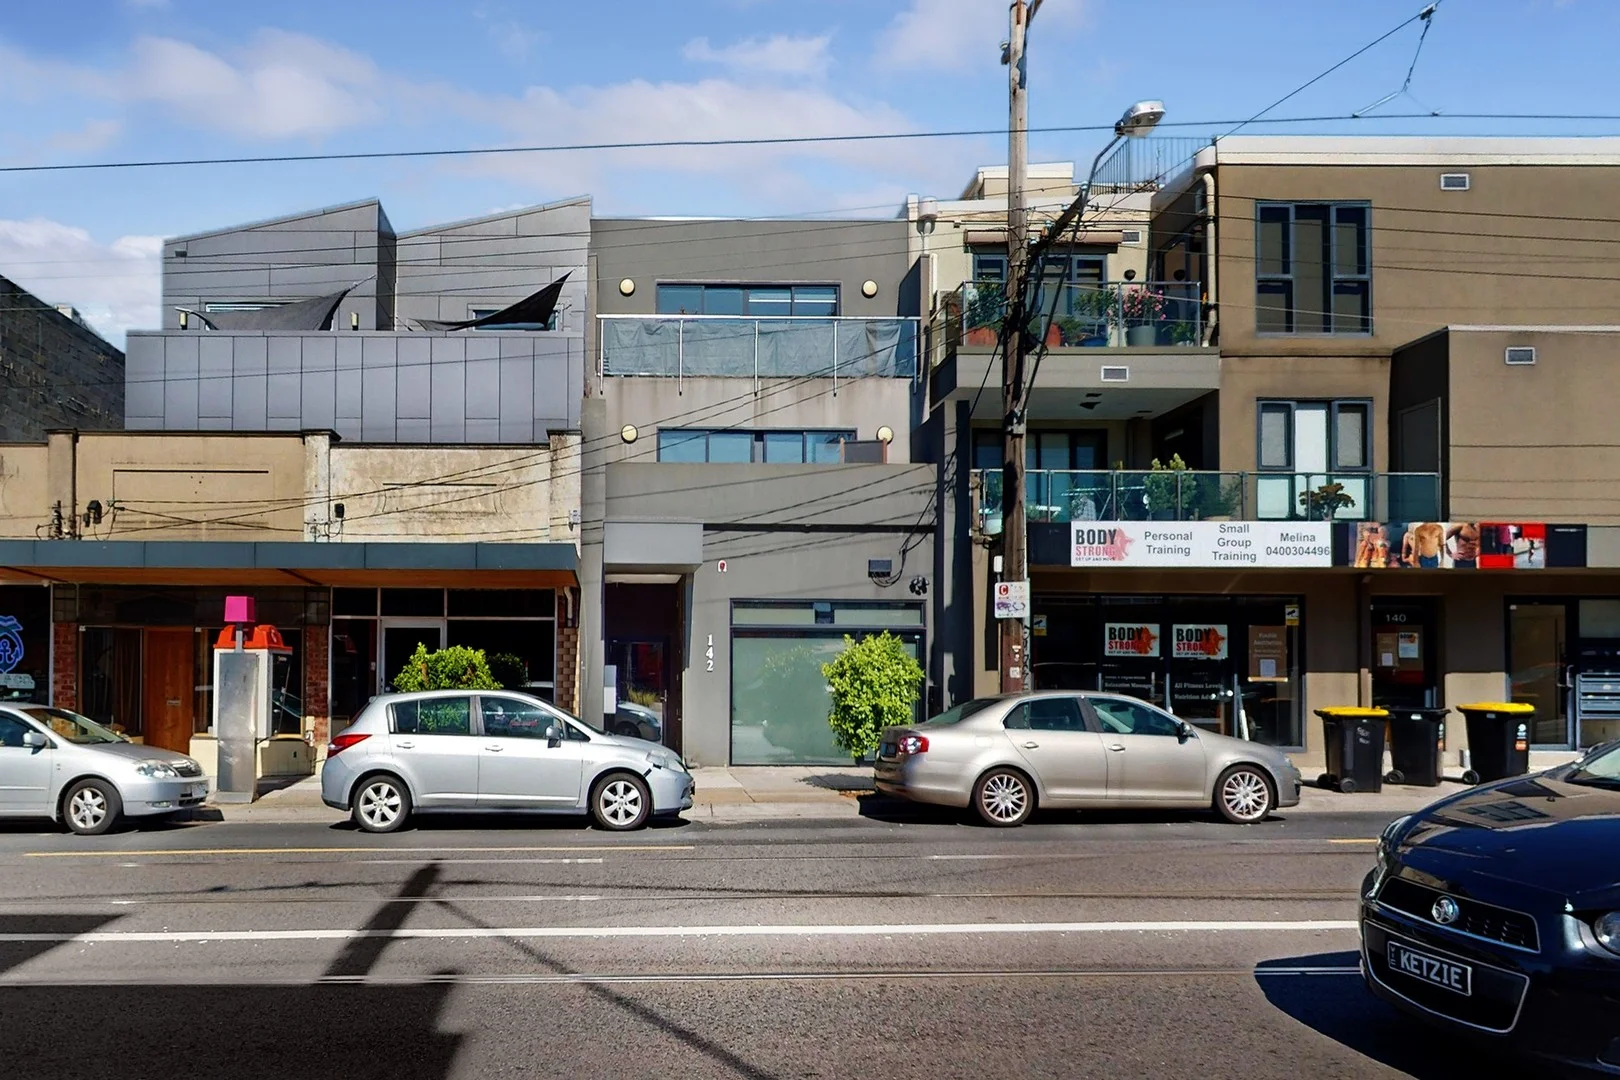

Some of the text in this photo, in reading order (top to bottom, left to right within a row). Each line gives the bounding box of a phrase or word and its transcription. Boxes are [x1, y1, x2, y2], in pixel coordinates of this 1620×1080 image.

[1219, 523, 1250, 534] Small
[1075, 529, 1117, 545] BODY
[1144, 531, 1193, 541] Personal
[1280, 532, 1316, 542] Melina
[1217, 537, 1252, 549] Group
[1075, 546, 1116, 557] STRONG
[1146, 544, 1191, 557] Training
[1265, 546, 1331, 556] 0400304496
[1211, 551, 1257, 563] Training
[1386, 613, 1407, 623] 140
[1108, 626, 1144, 641] BODY
[1176, 628, 1211, 642] BODY
[705, 634, 714, 671] 142
[1399, 948, 1463, 990] KETZIE
